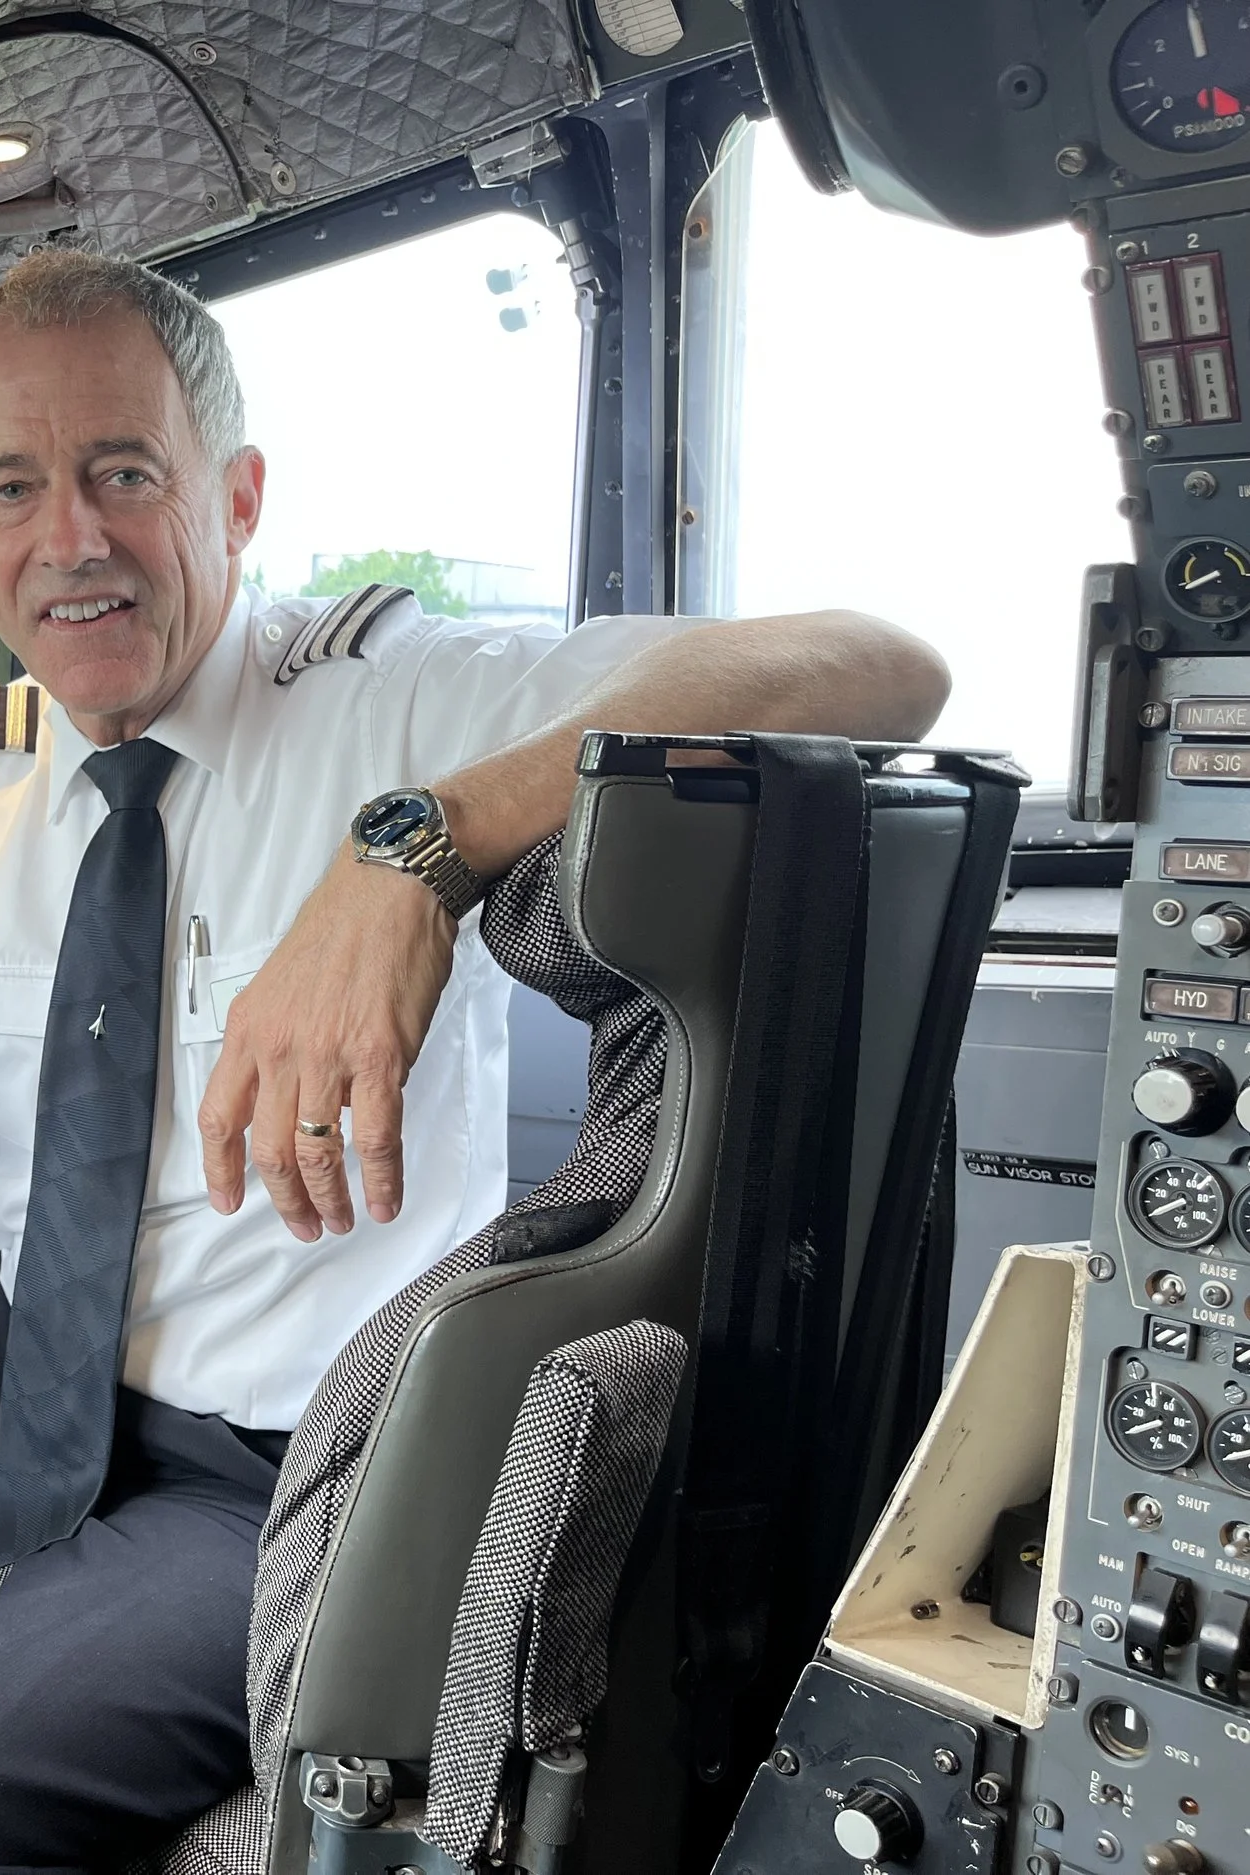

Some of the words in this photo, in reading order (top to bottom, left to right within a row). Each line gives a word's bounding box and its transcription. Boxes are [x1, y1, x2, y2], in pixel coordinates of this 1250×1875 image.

[1141, 240, 1148, 255] 1
[1187, 233, 1200, 249] 2
[1157, 365, 1171, 418] REAR
[1203, 359, 1219, 414] REAR
[1187, 708, 1247, 725] INTAKE
[1214, 755, 1241, 771] SIG
[1185, 853, 1228, 871] LANE
[1174, 989, 1207, 1008] HYD
[1145, 1030, 1177, 1045] AUTO
[1216, 1039, 1225, 1051] G
[968, 1162, 999, 1176] SUN
[1004, 1165, 1053, 1182] VISOR
[1167, 1177, 1179, 1188] 40
[1186, 1178, 1197, 1188] 60
[1155, 1188, 1167, 1198] 20
[1197, 1193, 1209, 1203] 80
[1192, 1210, 1206, 1221] 100
[1200, 1262, 1237, 1281] RAISE
[1192, 1307, 1235, 1328] LOWER
[1133, 1407, 1144, 1417] 20
[1163, 1402, 1174, 1412] 60
[1174, 1417, 1185, 1427] 80
[1168, 1434, 1181, 1444] 100
[1177, 1494, 1211, 1513] SHUT
[1172, 1539, 1206, 1558] OPEN
[1098, 1554, 1124, 1571] MAN
[1091, 1594, 1122, 1613] AUTO
[1164, 1745, 1190, 1764] SYS
[825, 1787, 845, 1801] OFF
[1176, 1819, 1197, 1837] DG
